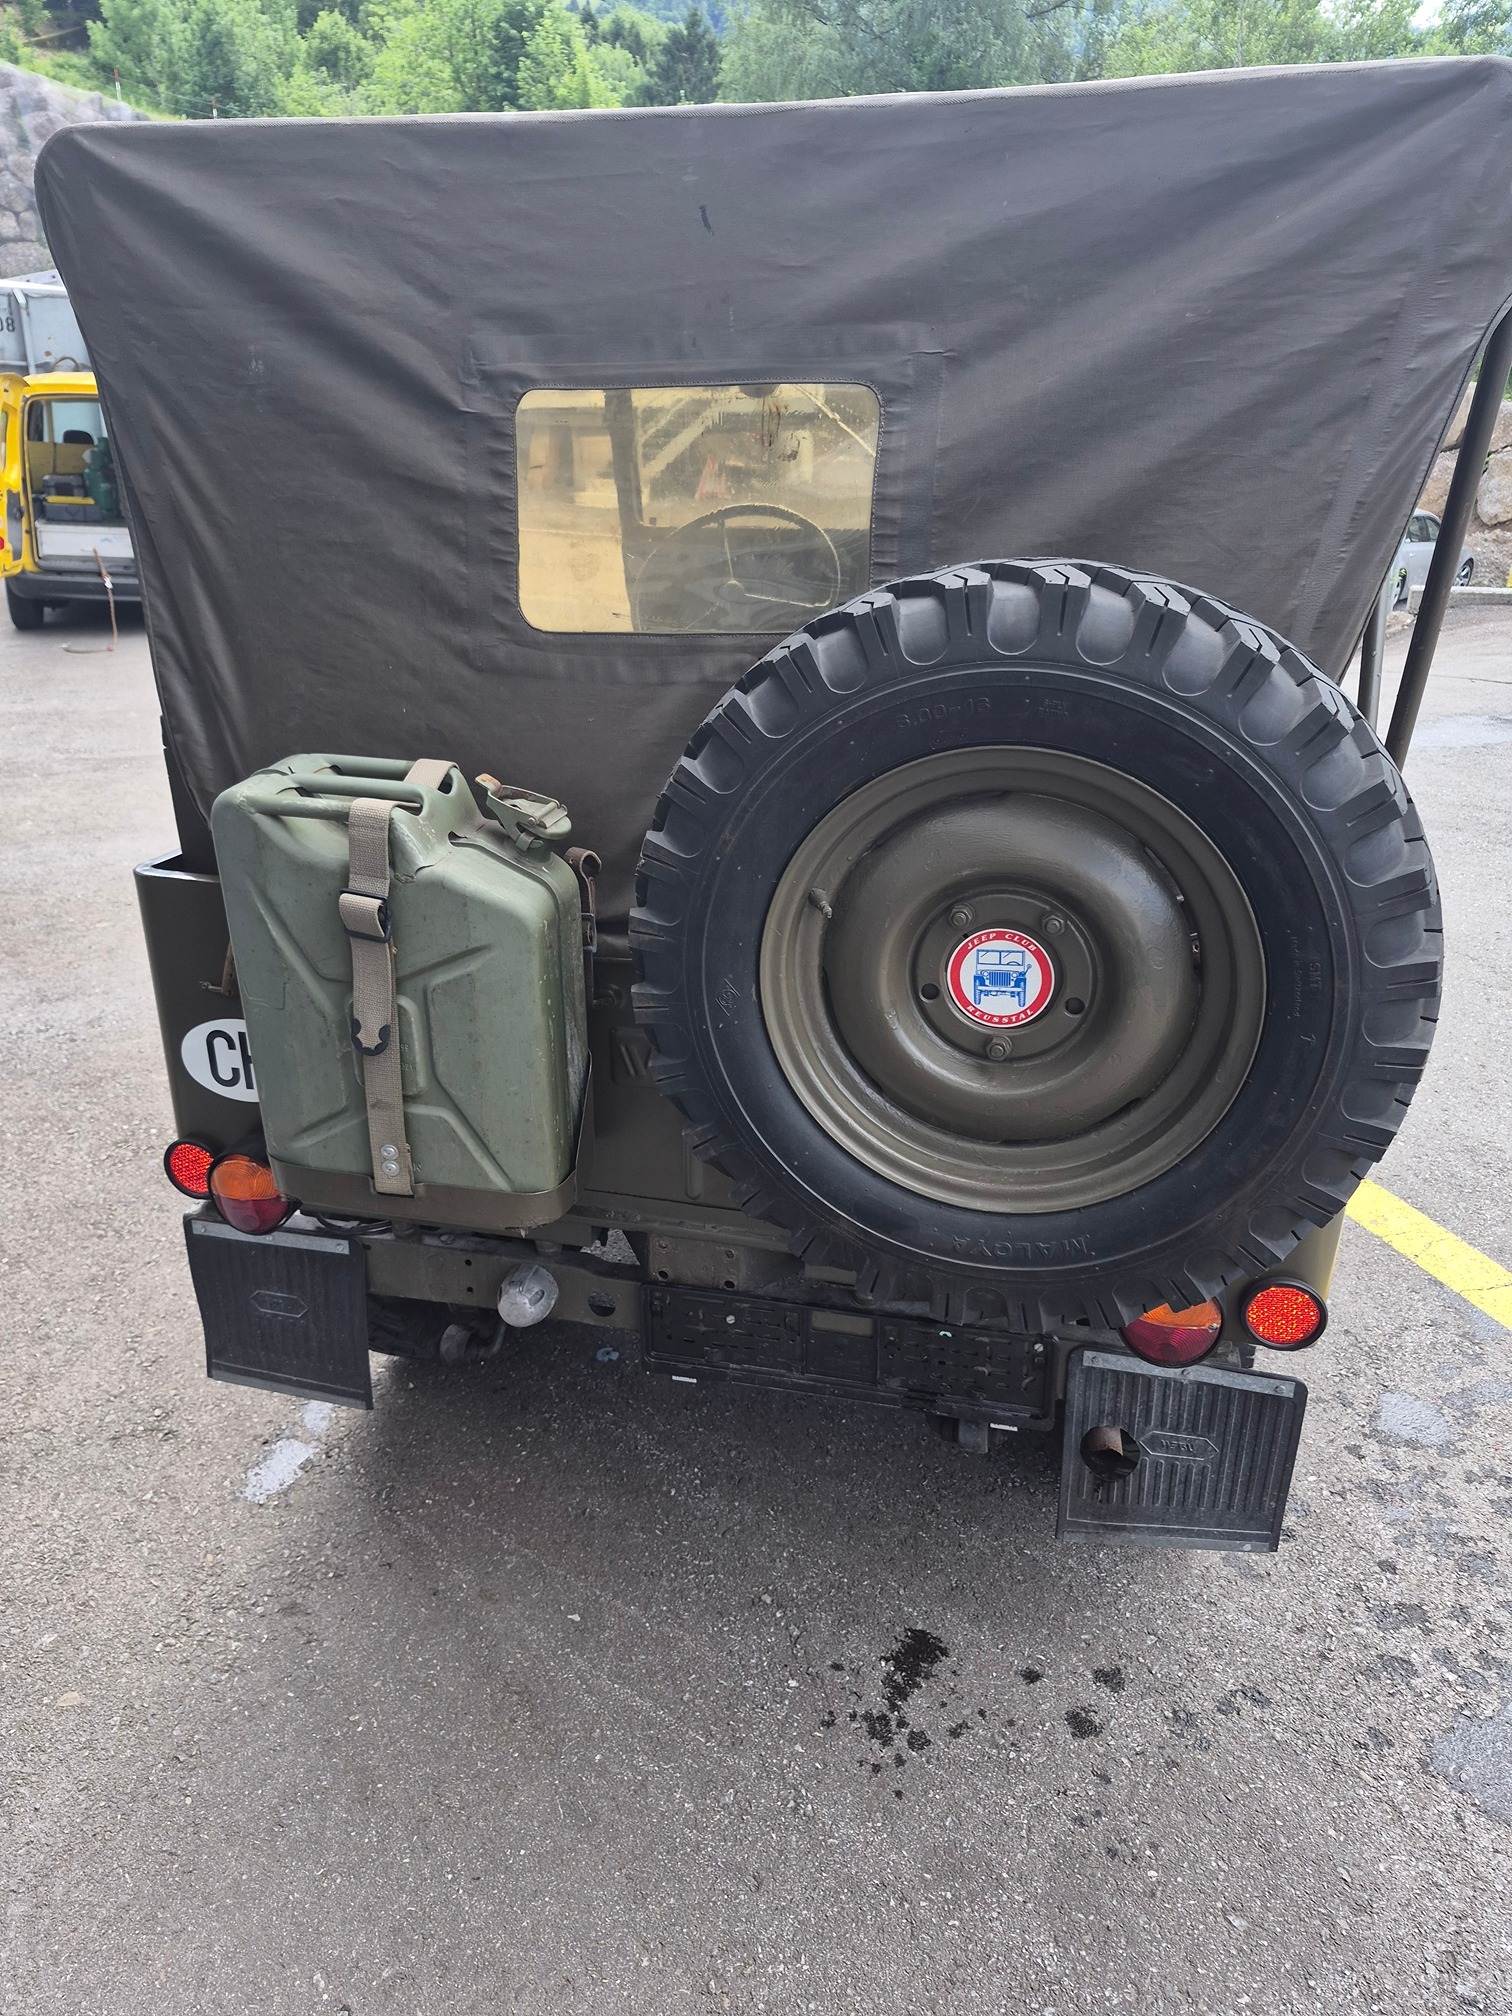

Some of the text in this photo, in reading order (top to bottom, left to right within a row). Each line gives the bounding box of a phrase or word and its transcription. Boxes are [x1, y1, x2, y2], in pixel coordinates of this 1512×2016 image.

[967, 933, 1037, 951] JEEP CLUB
[966, 1005, 1034, 1024] REUSSTAL
[951, 1235, 1088, 1259] MALOYA
